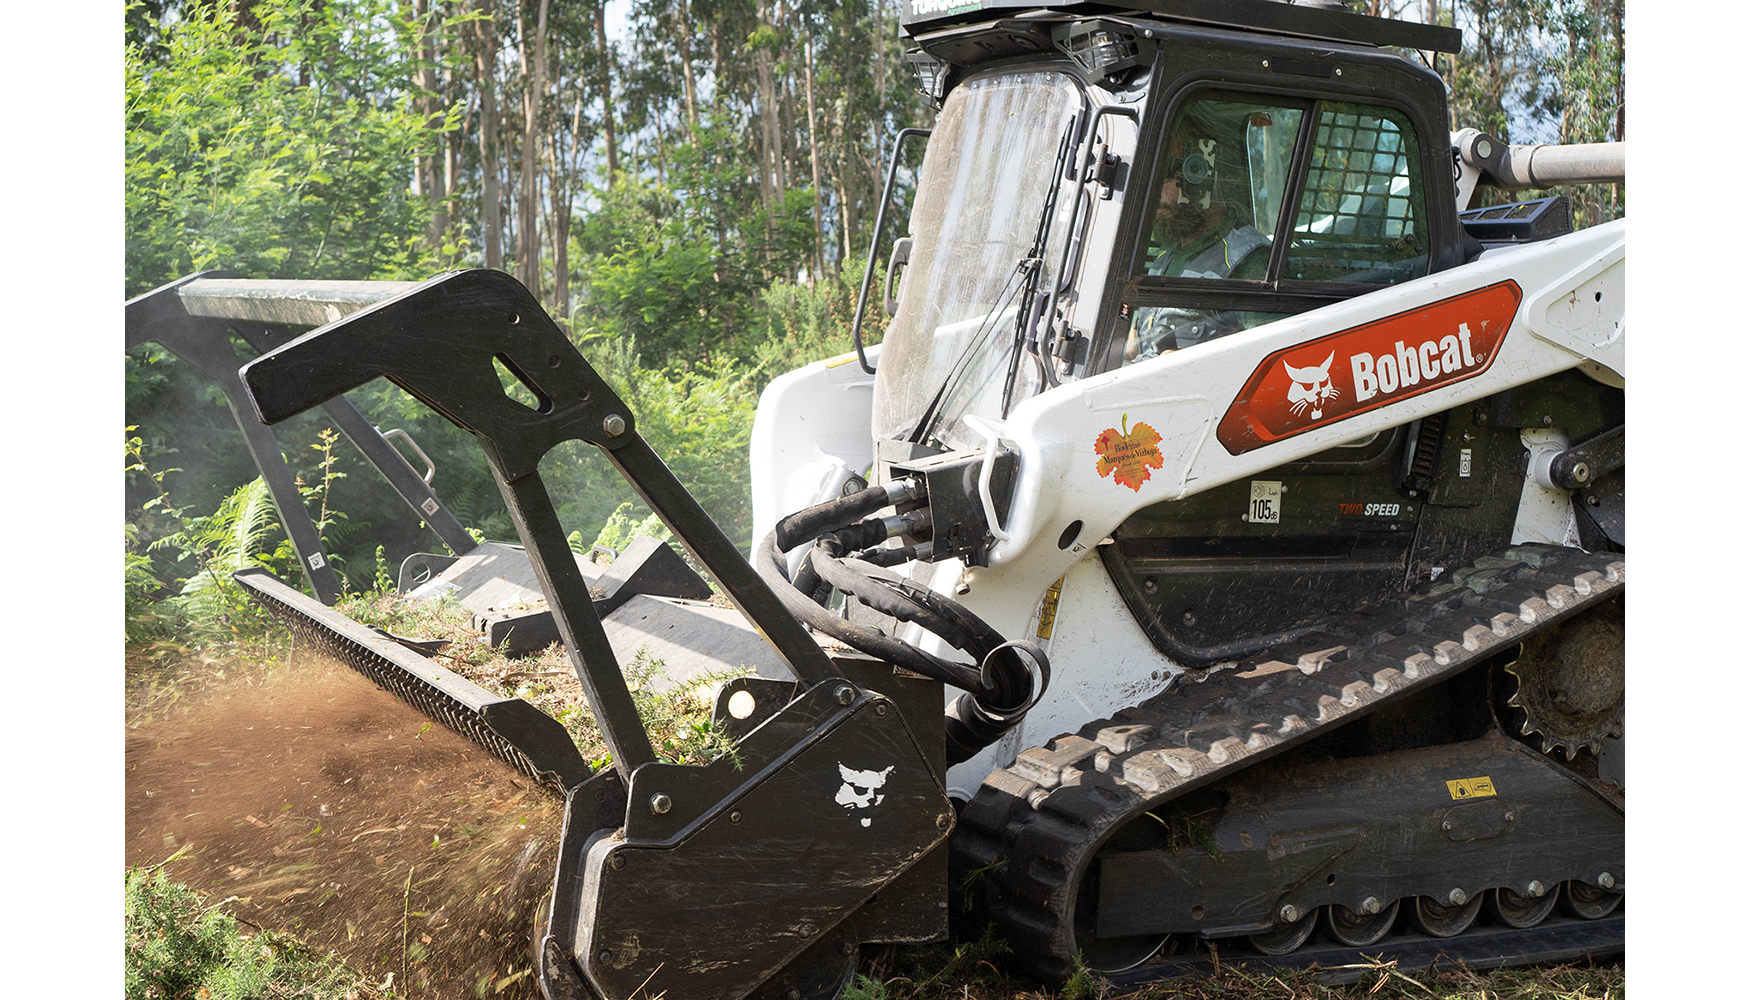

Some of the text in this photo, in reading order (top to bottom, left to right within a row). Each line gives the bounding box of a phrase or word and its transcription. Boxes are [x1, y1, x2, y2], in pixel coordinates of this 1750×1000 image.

[1350, 322, 1475, 402] Bobcat
[1339, 503, 1400, 516] TWO SPEED
